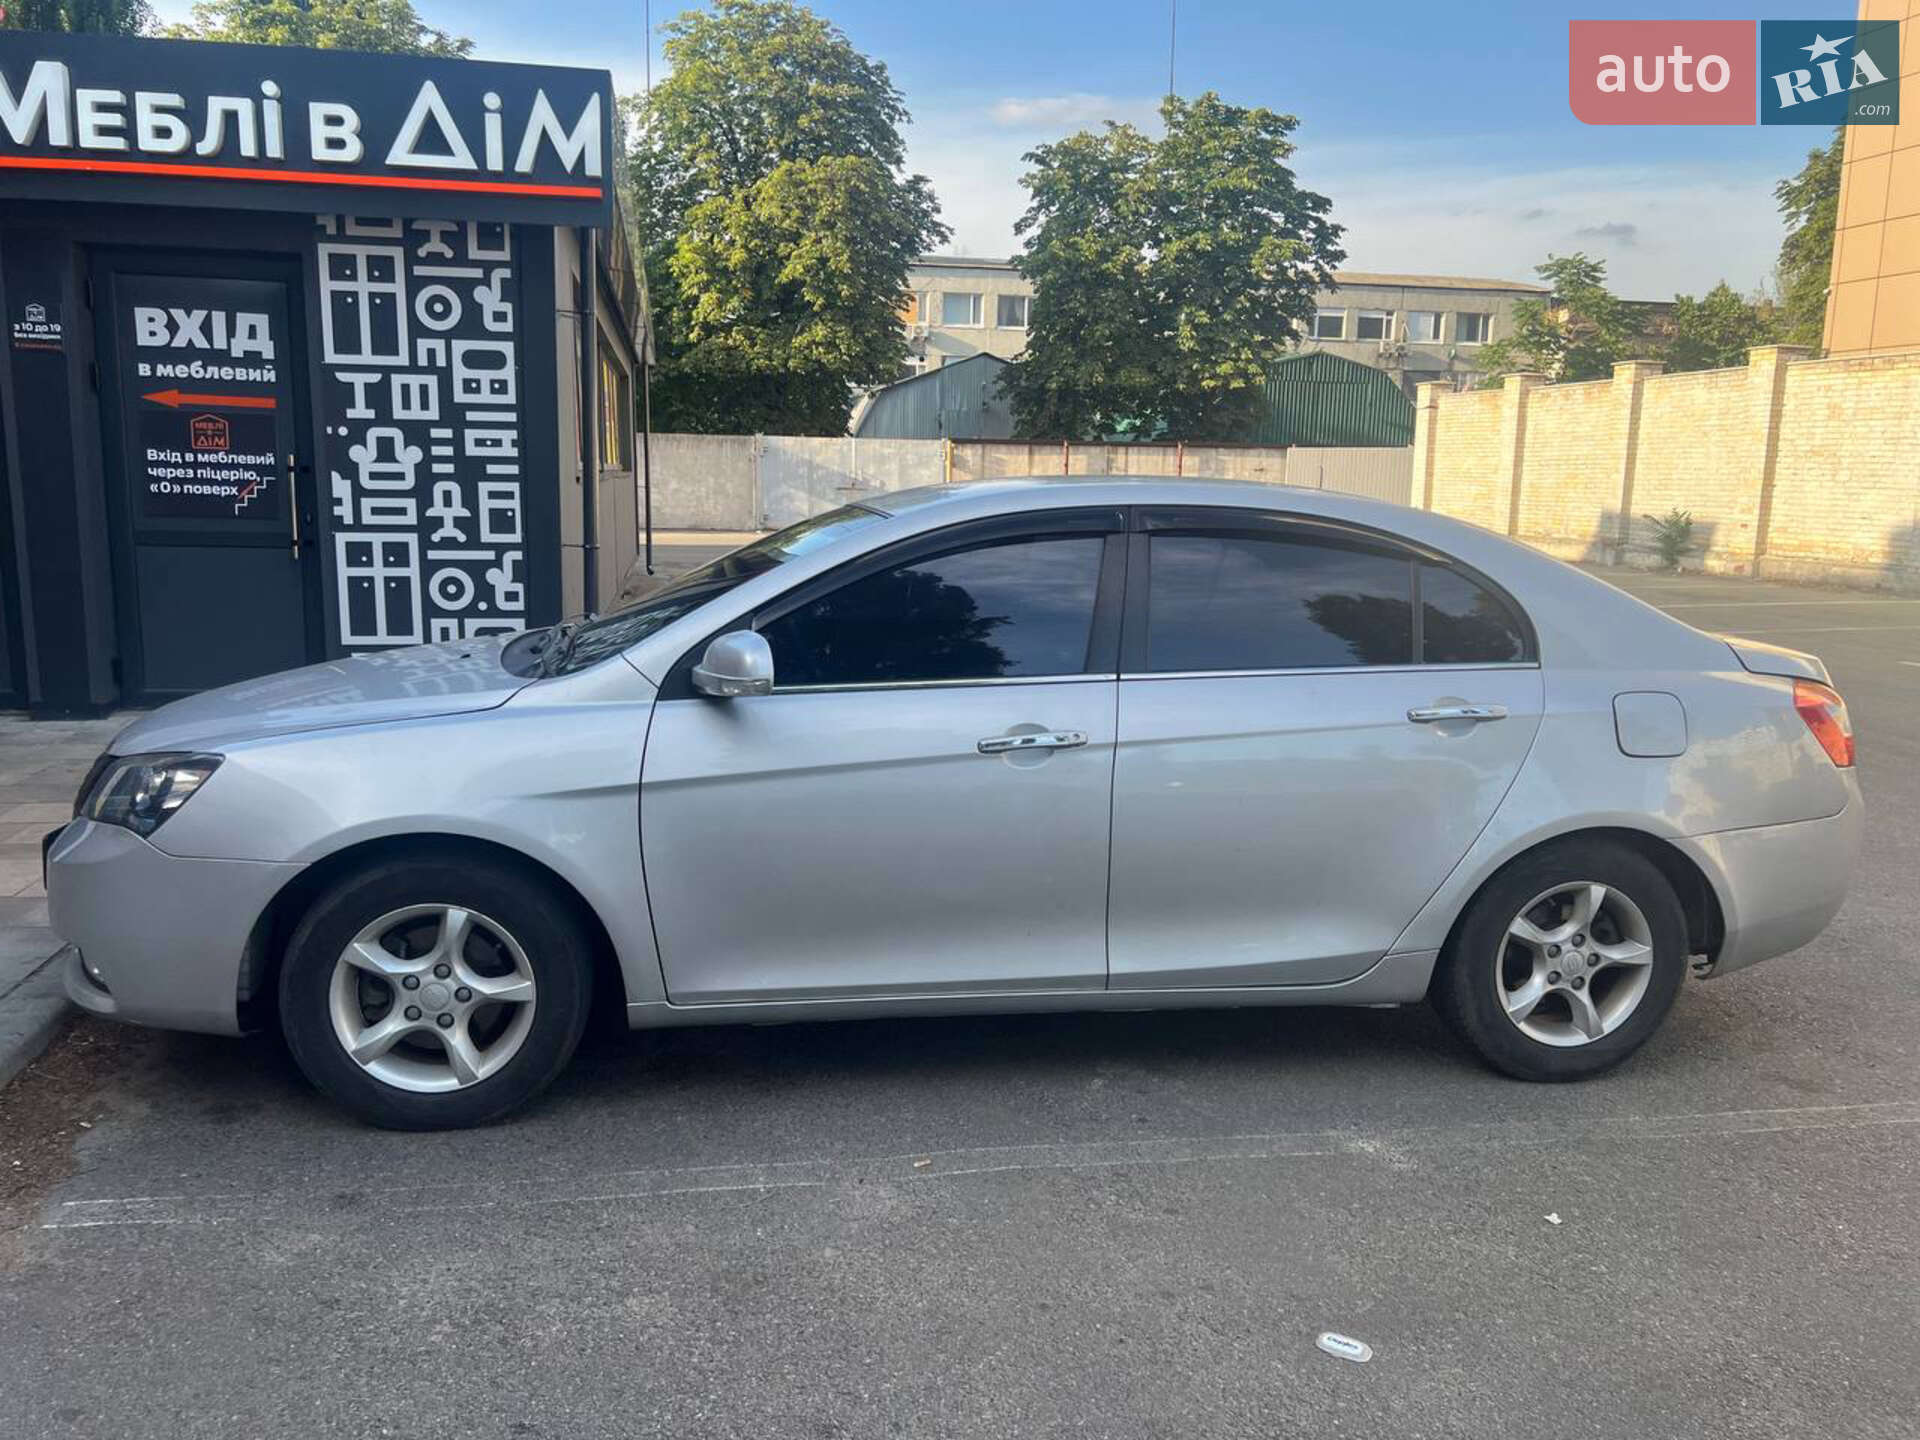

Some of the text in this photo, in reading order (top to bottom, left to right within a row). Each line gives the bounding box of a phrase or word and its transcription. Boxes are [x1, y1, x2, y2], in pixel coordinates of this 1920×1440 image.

[21, 323, 33, 331] 10
[35, 324, 49, 332] до
[134, 307, 275, 359] ВХІД
[138, 360, 277, 382] в меблевий
[146, 449, 275, 466] Вхід в меблевий
[147, 467, 261, 482] через піцерію,
[183, 484, 239, 497] поверх
